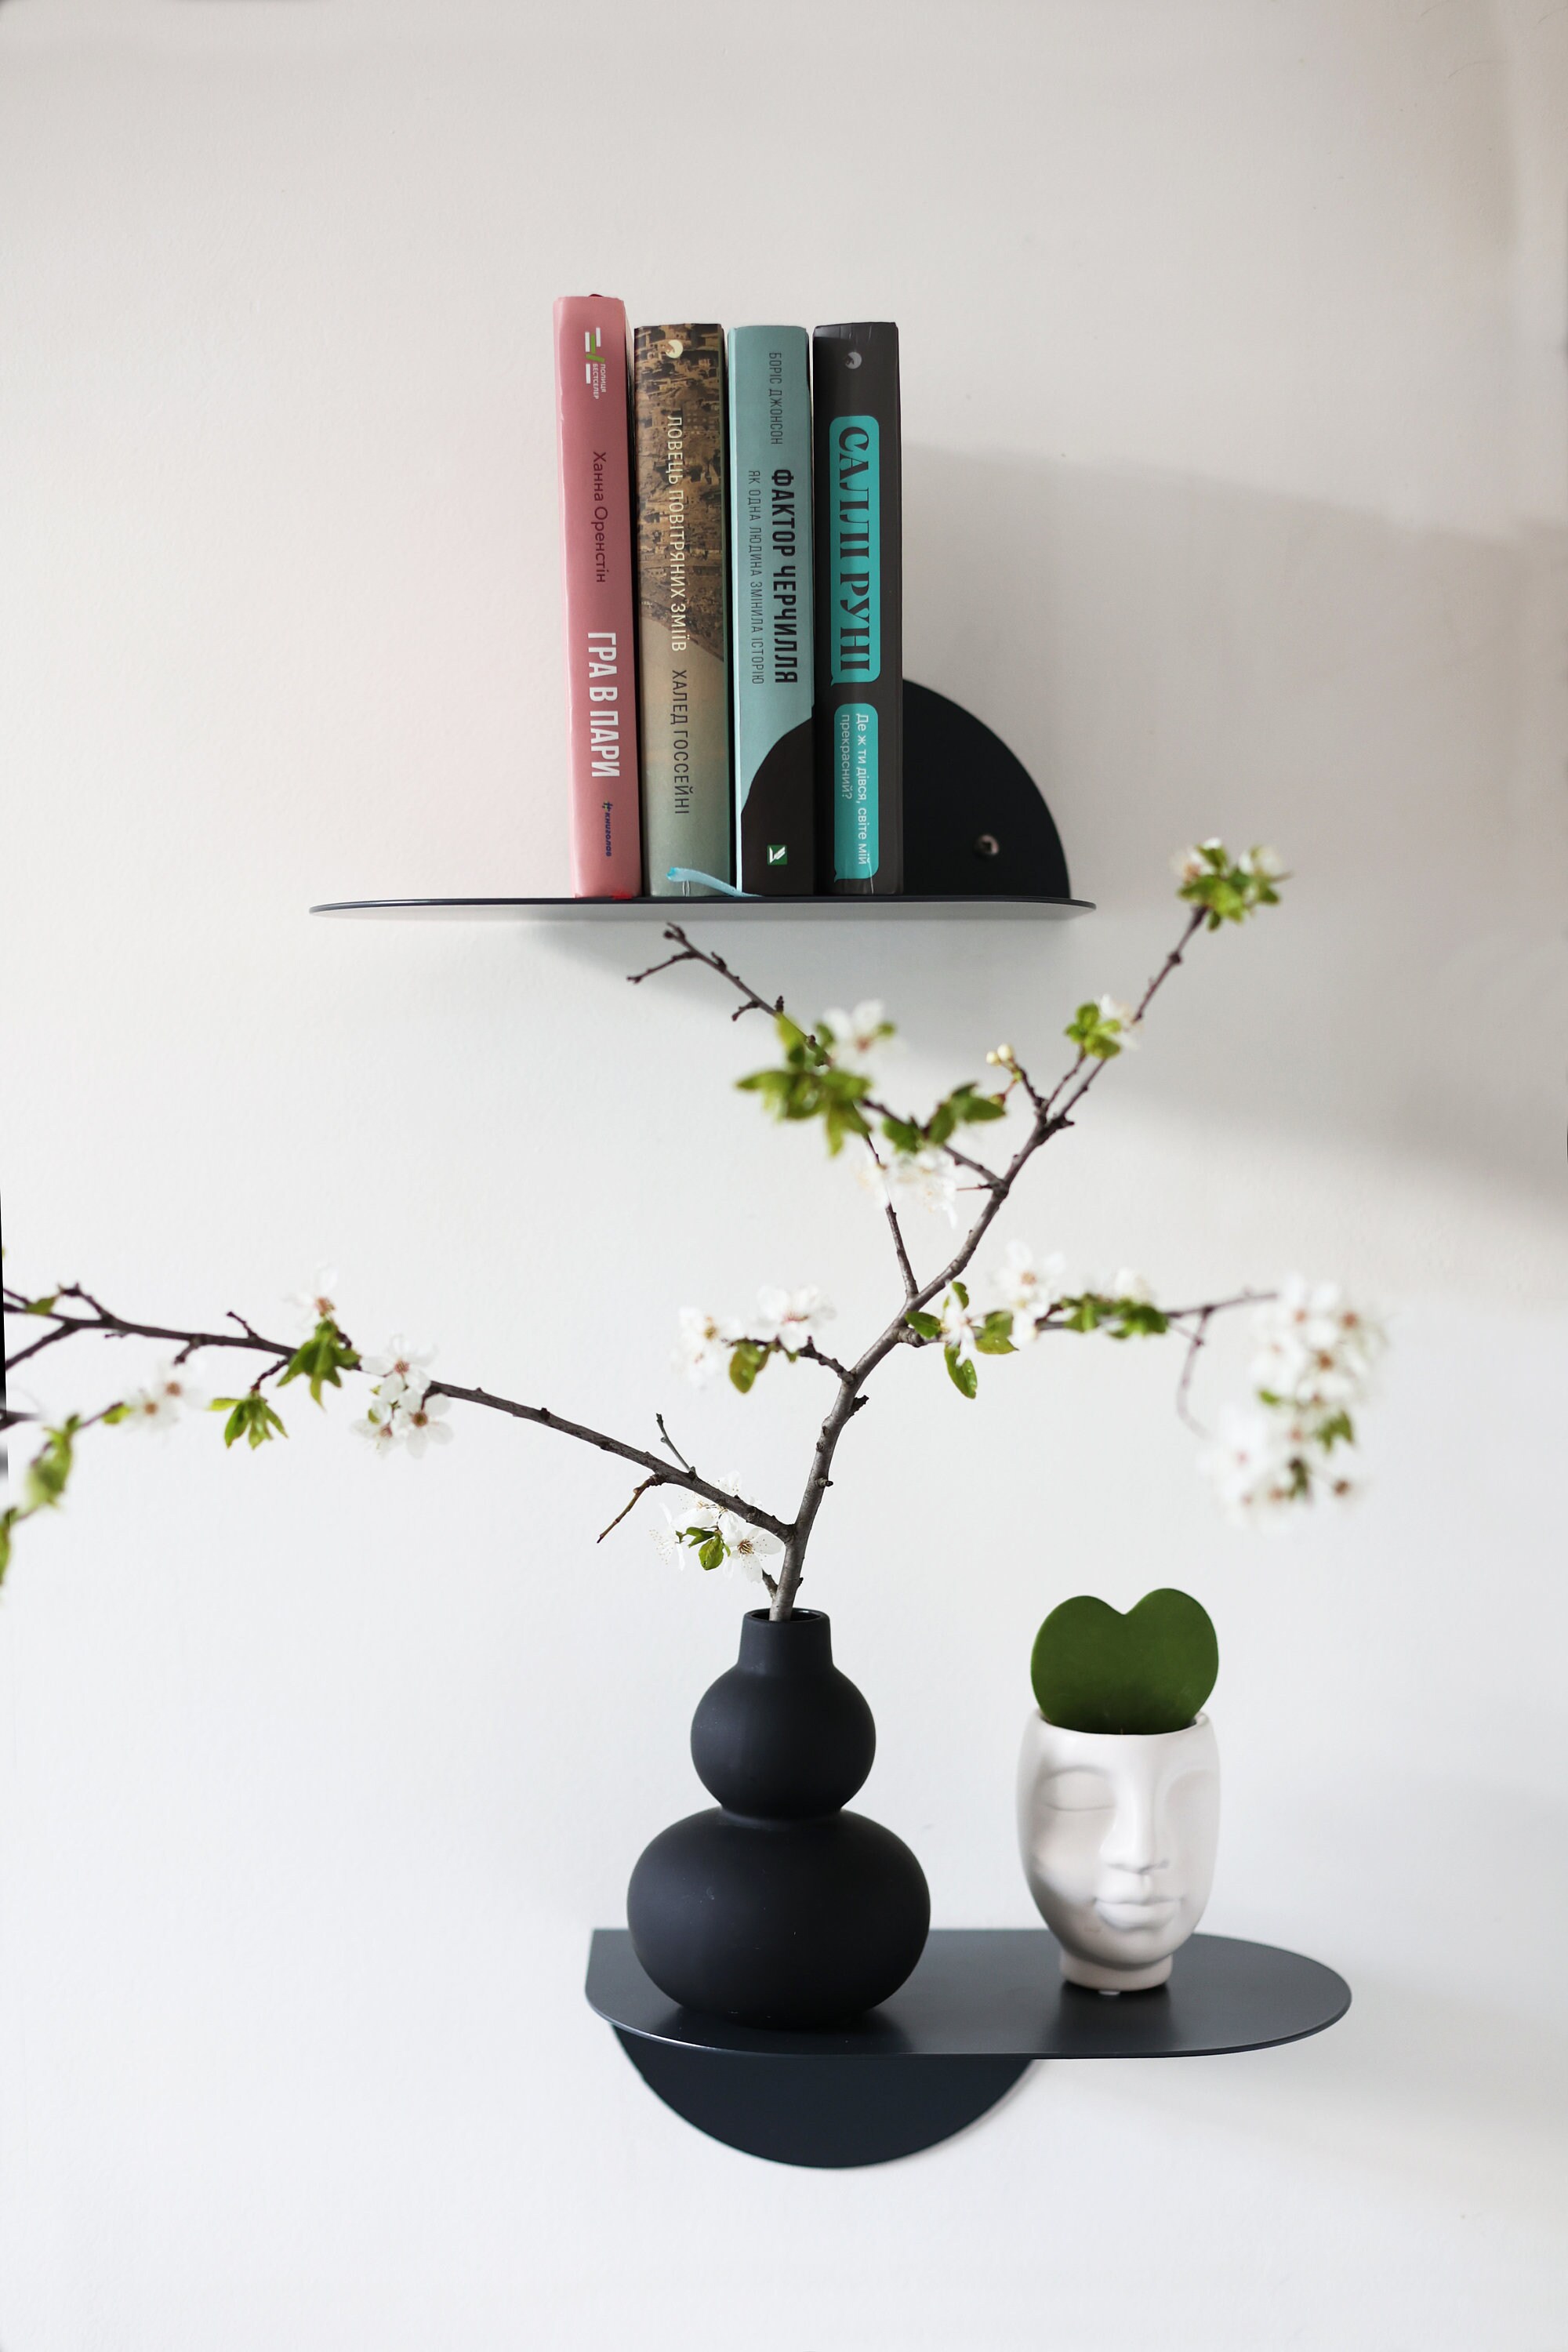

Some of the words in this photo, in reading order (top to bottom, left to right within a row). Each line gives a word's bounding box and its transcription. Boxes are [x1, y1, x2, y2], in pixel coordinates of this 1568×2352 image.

[769, 352, 782, 384] БОРІС
[769, 389, 783, 445] ДЖОНСОН
[666, 416, 684, 485] ЛОВЕЦЬ
[593, 452, 606, 501] Ханна
[749, 470, 760, 485] ЯК
[839, 426, 869, 559] САЛЛІ
[749, 490, 761, 521] ОДНА
[771, 469, 796, 557] ФАКТОР
[591, 506, 609, 583] Оренстін
[669, 490, 685, 598] ПОВІТРЯНИХ
[749, 527, 762, 576] ЛЮДИНА
[671, 603, 690, 652] ЗМІЇВ
[750, 582, 764, 633] ЗМІНИЛА
[773, 565, 797, 683] ЧЕРЧИЛЛЯ
[840, 572, 870, 671] РУНІ
[588, 633, 618, 678] ГРА
[751, 638, 764, 684] ІСТОРІЮ
[590, 687, 618, 702] В
[670, 670, 688, 724] ХАЛЕД
[590, 711, 619, 777] ПАРИ
[856, 713, 869, 731] Де
[858, 735, 866, 746] ж
[673, 731, 693, 814] ГОССЕЙНІ
[840, 714, 853, 800] прекрасний?
[858, 750, 866, 764] ти
[856, 768, 869, 804] дівся,
[858, 808, 869, 840] світе
[858, 844, 870, 865] мій
